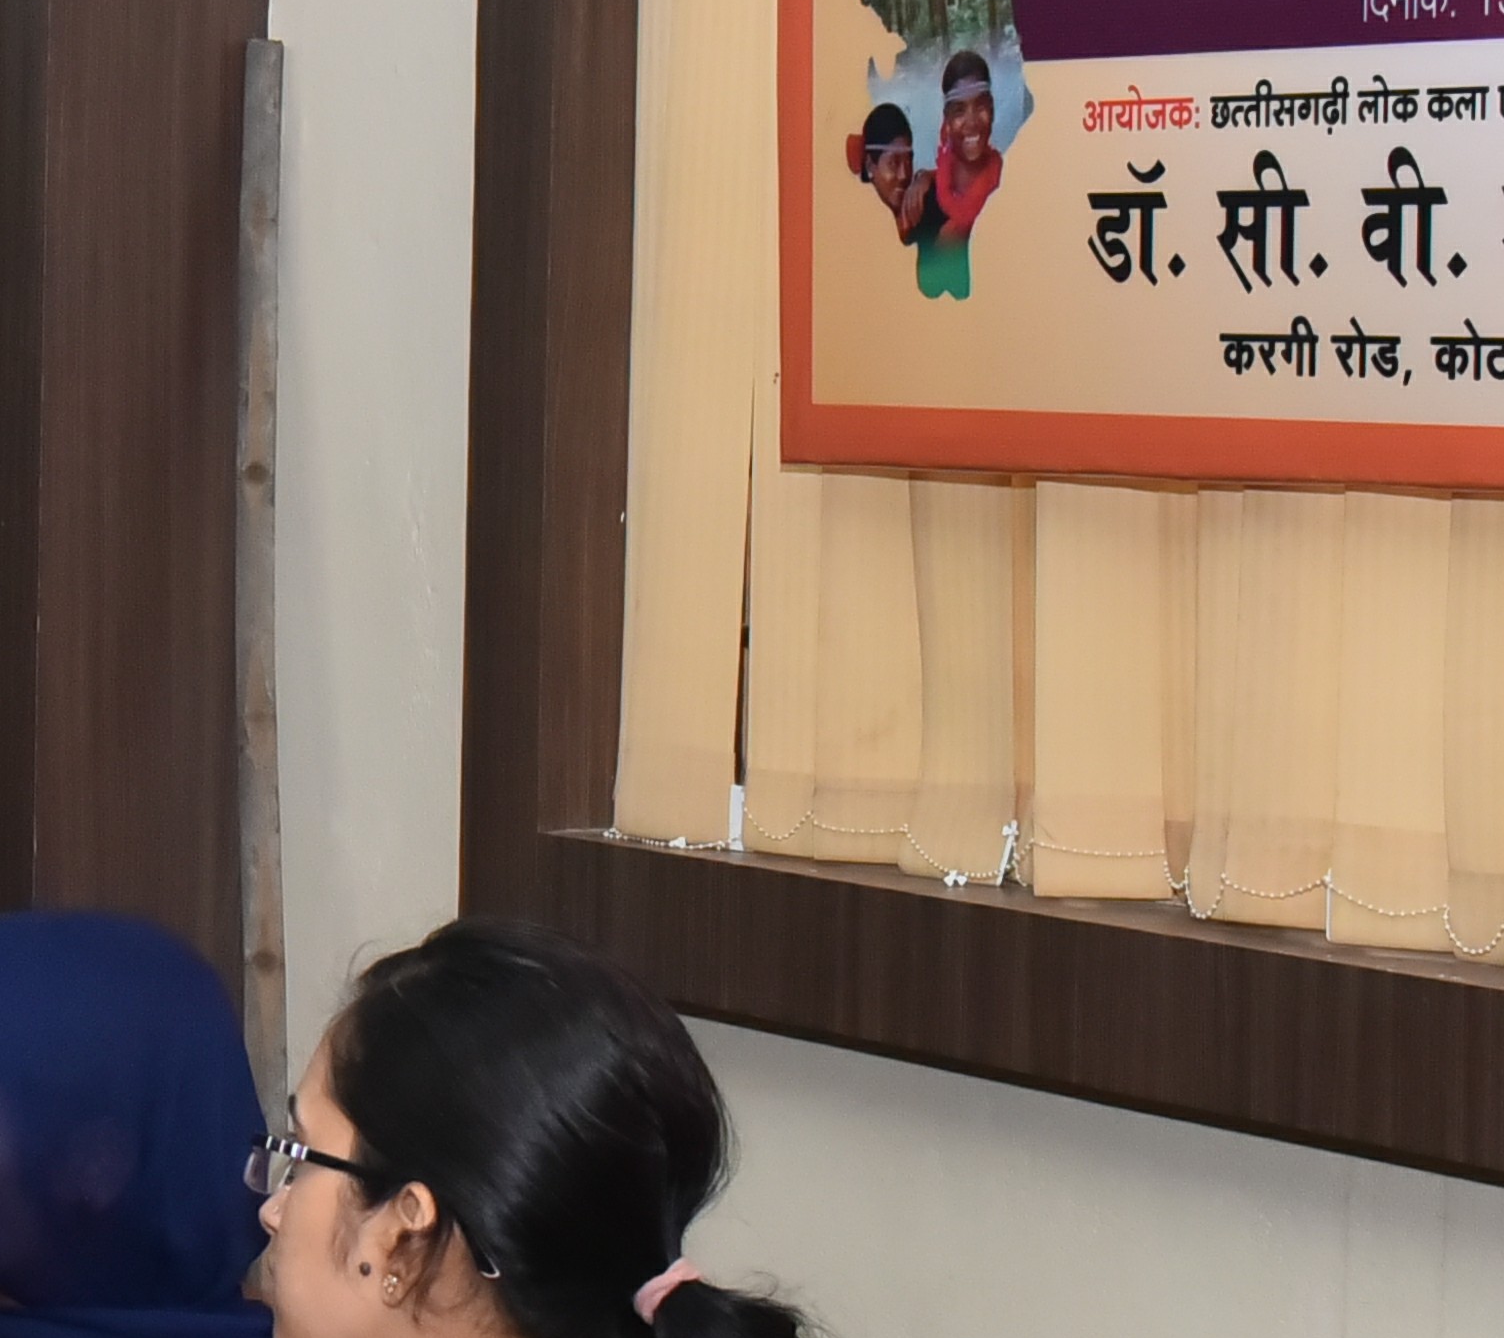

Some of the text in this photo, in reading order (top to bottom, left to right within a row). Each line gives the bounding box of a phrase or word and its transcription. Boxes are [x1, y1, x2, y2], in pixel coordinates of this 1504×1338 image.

[1082, 84, 1201, 133] आयोजक:
[1210, 76, 1349, 135] छत्तीसगढ़ी
[1357, 74, 1418, 125] लोक
[1427, 85, 1488, 122] कला
[1086, 159, 1186, 287] डॉ.
[1216, 149, 1329, 293] सी.
[1361, 146, 1468, 288] वी.
[1219, 315, 1319, 378] करगी
[1331, 316, 1413, 386] रोड,
